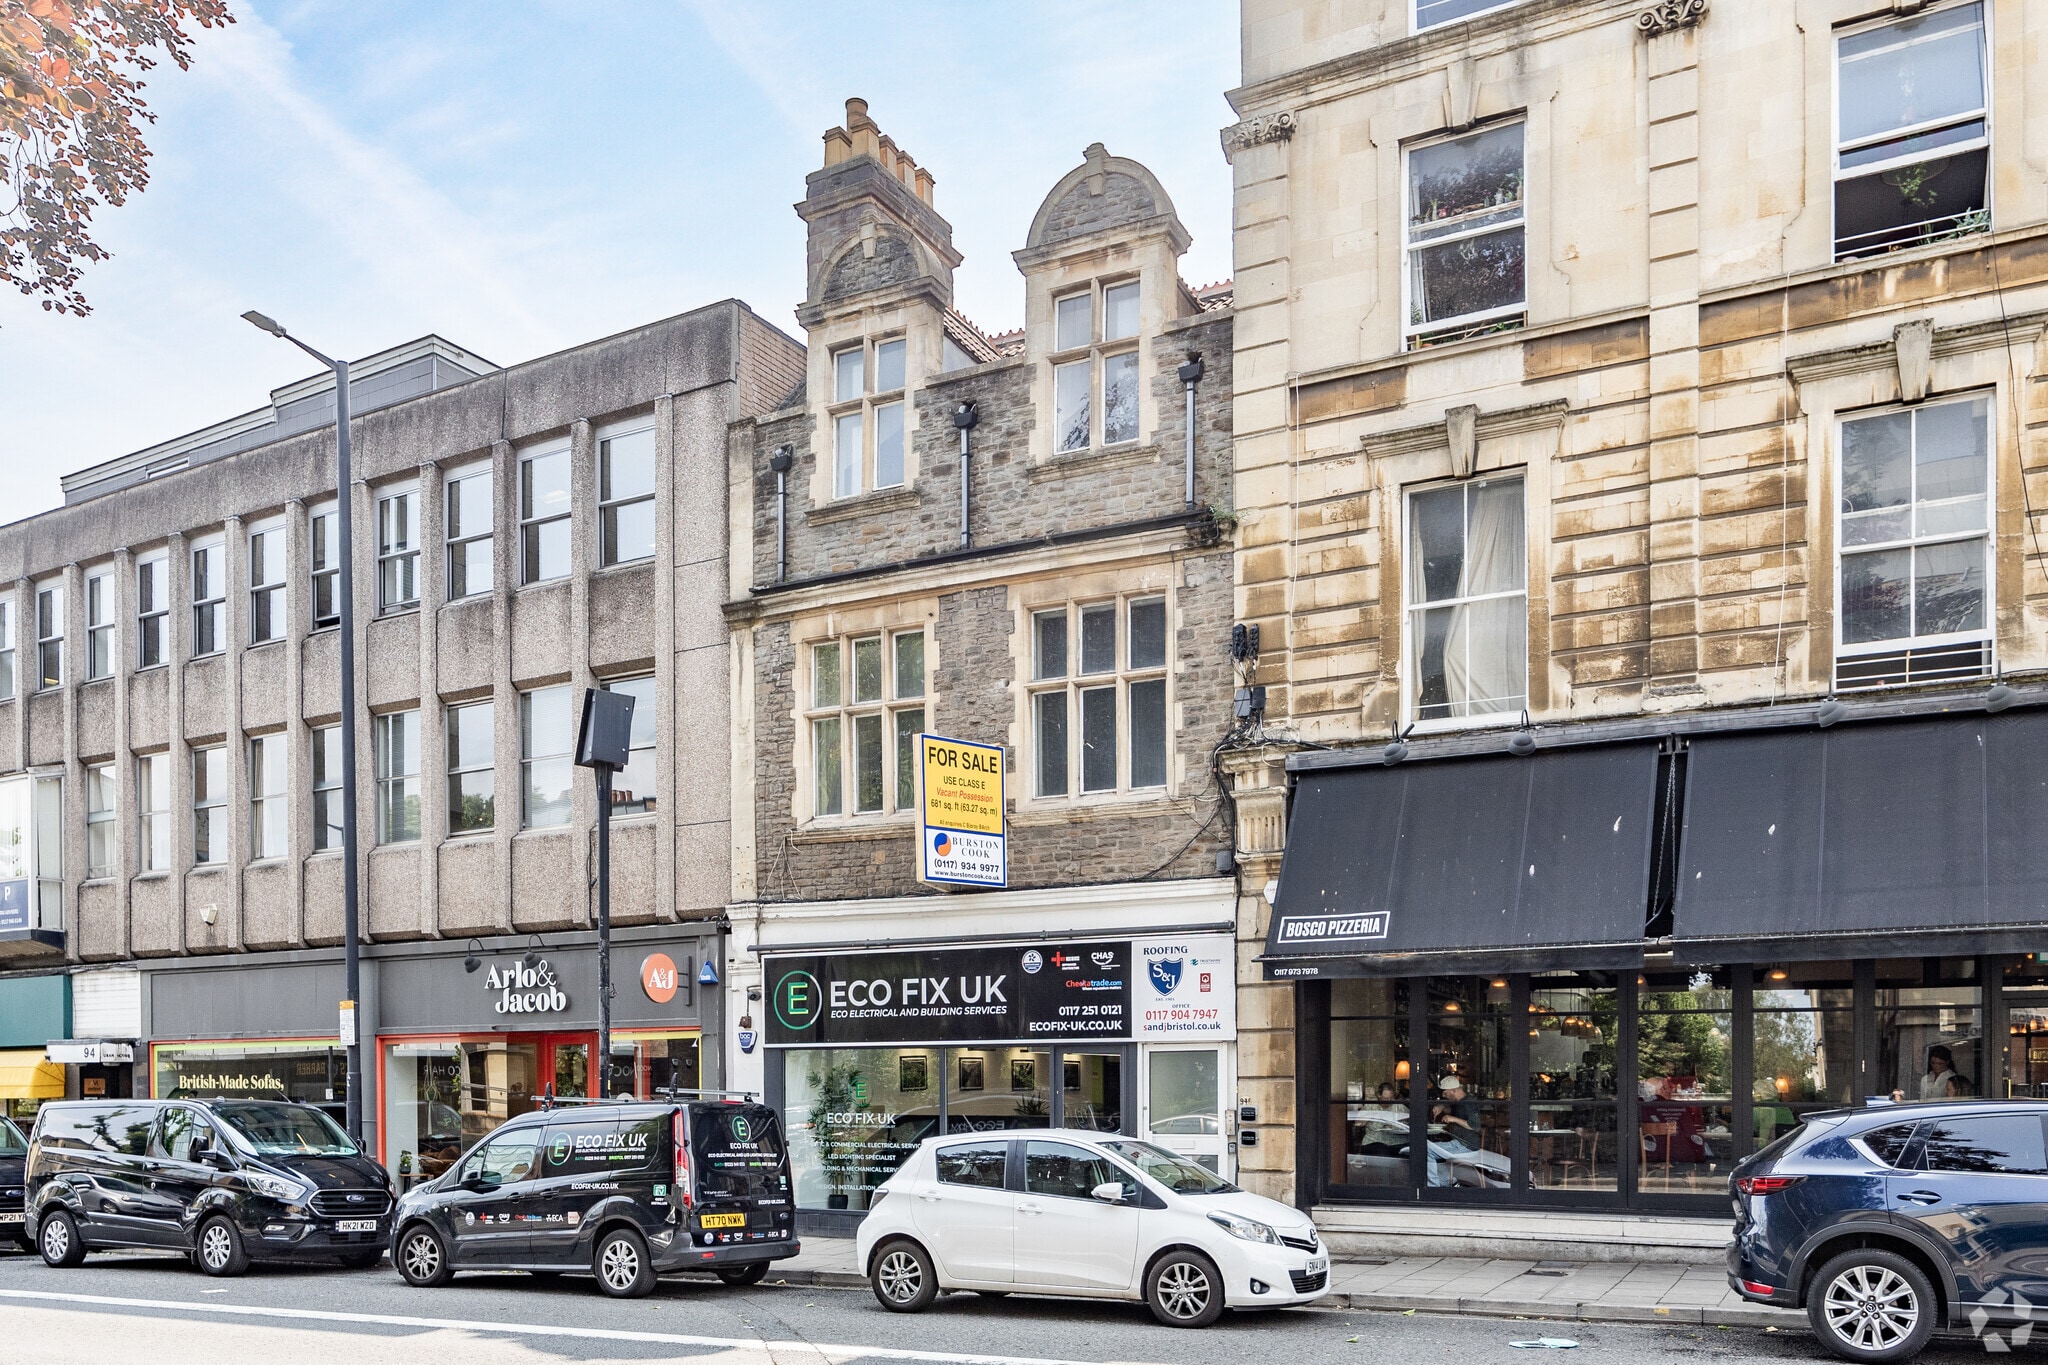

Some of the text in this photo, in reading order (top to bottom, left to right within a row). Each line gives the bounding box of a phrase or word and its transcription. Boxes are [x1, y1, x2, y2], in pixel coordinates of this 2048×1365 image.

[928, 746, 998, 774] FOR SALE
[944, 776, 986, 790] USE CLASS E
[936, 787, 994, 802] Vacant Possession
[931, 798, 998, 817] 681 sq. ft (63.27 sq. m)
[952, 836, 999, 849] BURSTON
[961, 848, 990, 858] COOK
[934, 858, 999, 873] (0117) 934 9977
[934, 870, 1000, 880] www.burstoncook.co.uk
[1286, 918, 1380, 937] BOSCO PIZZERIA
[1091, 952, 1114, 960] CHAS
[1144, 946, 1188, 955] ROOFING
[484, 960, 557, 989] Arlo&
[648, 968, 674, 989] A&J
[1153, 963, 1176, 989] S&J
[830, 974, 1007, 1007] ECO FIX UK
[495, 986, 567, 1014] Jacob
[788, 982, 808, 1015] E
[830, 1005, 1007, 1019] ECO ELECTRICAL AND BUILDING SERVICES
[1059, 1005, 1122, 1016] 0117 251 0121
[1146, 1009, 1218, 1020] 0117 904 7947
[1030, 1020, 1122, 1031] ECOFIX-UK.CO.UK
[1144, 1022, 1221, 1032] sandjbristol.co.uk
[84, 1047, 95, 1058] 94
[2033, 1051, 2048, 1059] BOS
[179, 1073, 285, 1091] British-Made Sofas,
[855, 1082, 867, 1099] E
[827, 1113, 896, 1124] ECO FIX UK
[736, 1121, 747, 1136] E
[576, 1133, 648, 1148] ECO FIX UK
[554, 1139, 566, 1157] E
[552, 1214, 563, 1222] ECA
[705, 1215, 742, 1226] HT70 NWK
[342, 1222, 359, 1230] HK21
